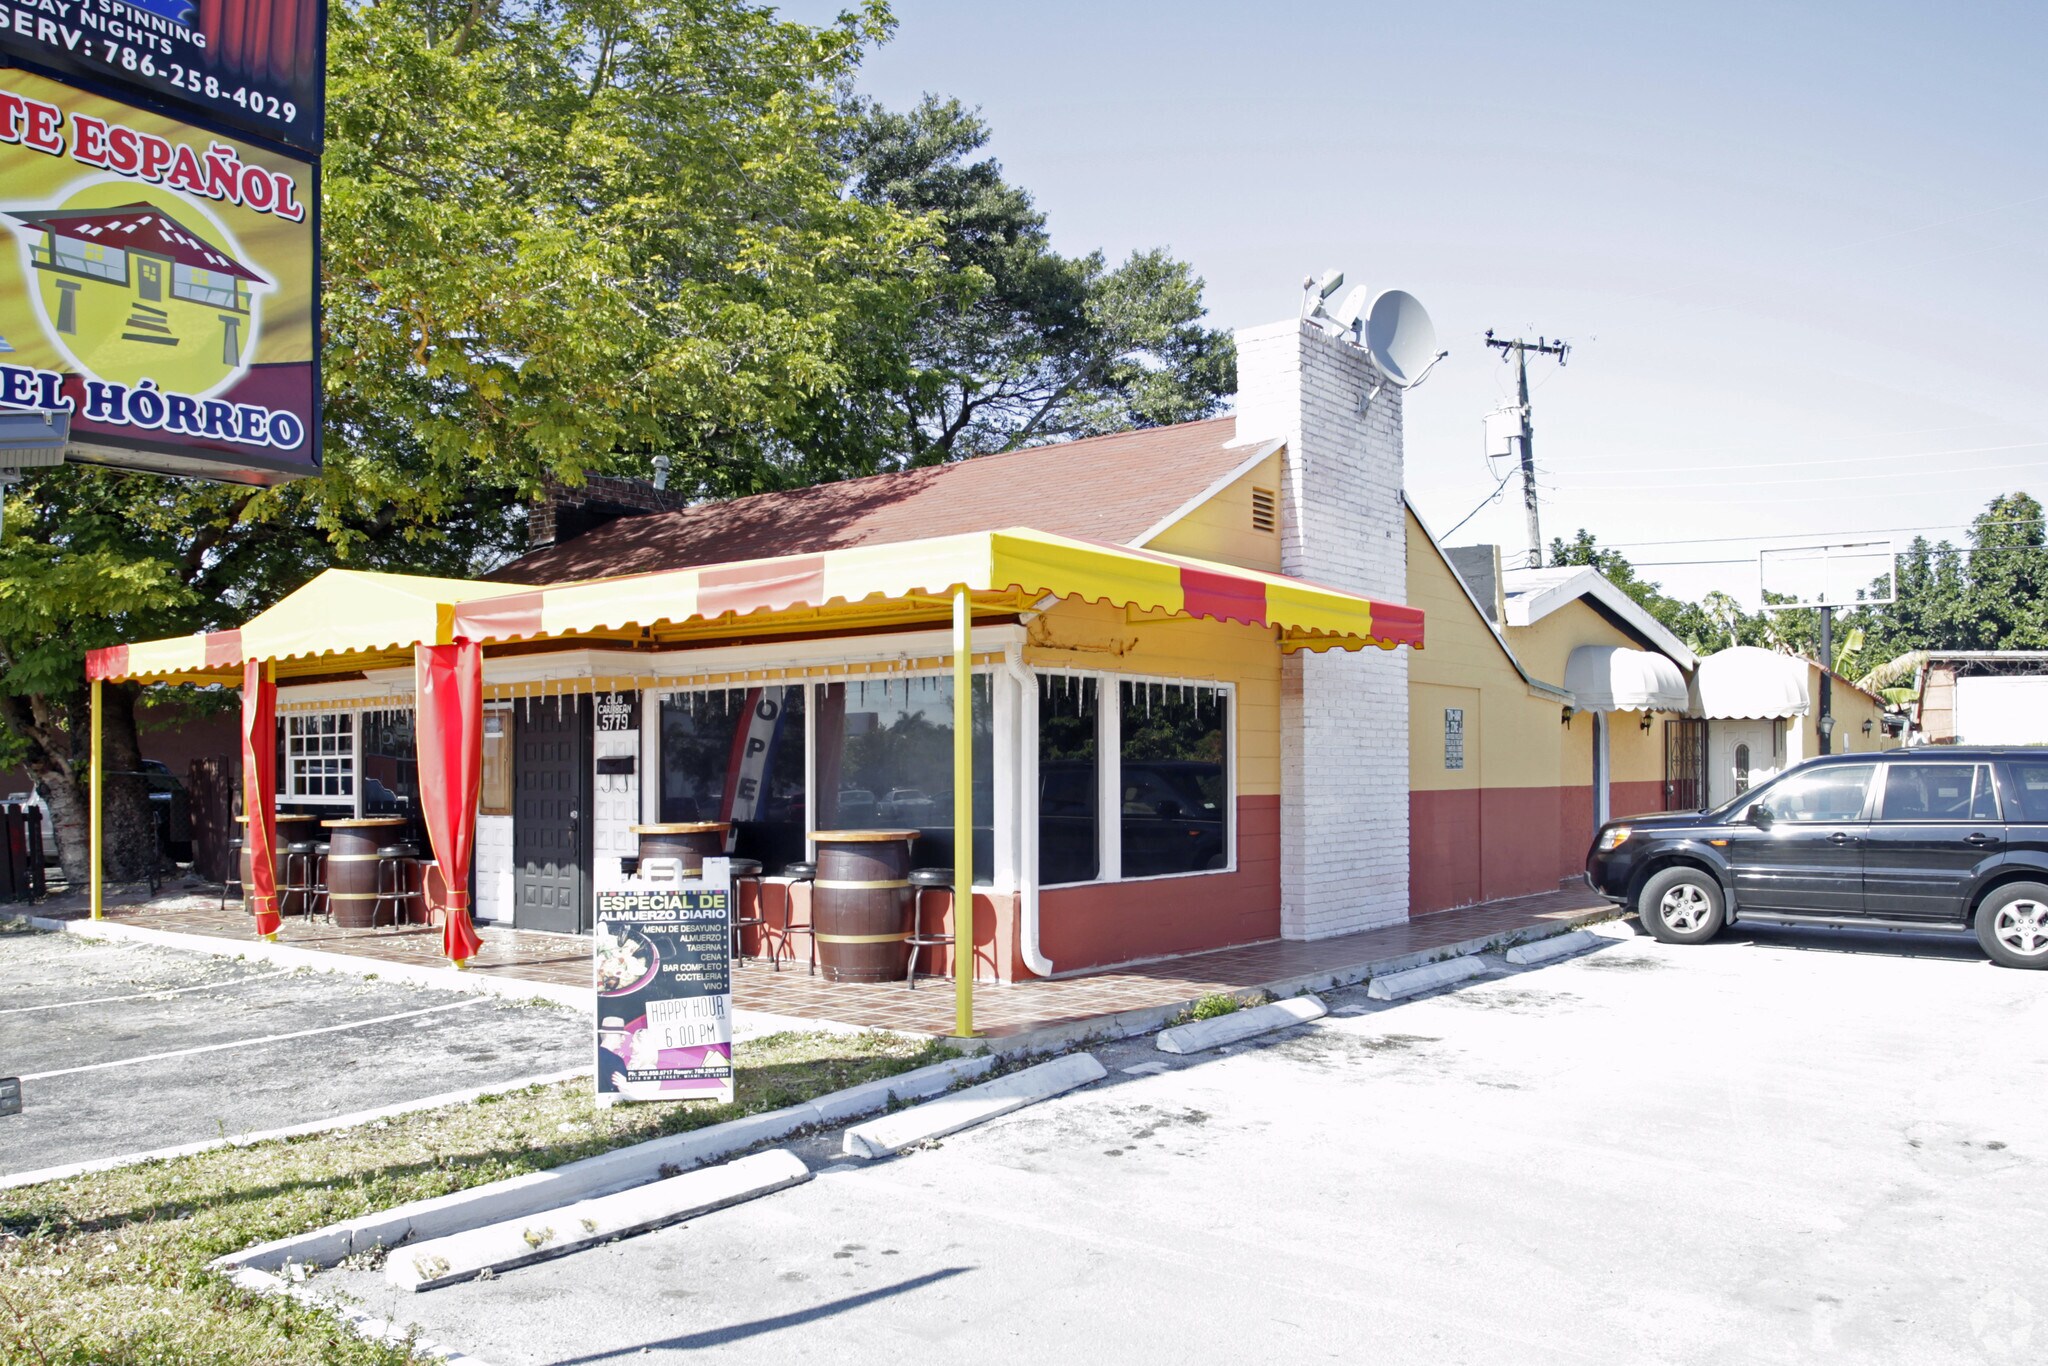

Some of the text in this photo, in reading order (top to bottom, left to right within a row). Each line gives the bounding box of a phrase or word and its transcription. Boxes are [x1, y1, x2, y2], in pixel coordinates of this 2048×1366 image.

[80, 9, 173, 55] NIGHTS
[100, 0, 206, 48] SPINNING
[103, 39, 297, 124] 786-258-4029
[71, 113, 304, 222] ESPAÑOL
[0, 363, 305, 450] EL HÓRREO
[602, 714, 629, 731] 5779
[599, 895, 725, 911] ESPECIAL DE
[599, 909, 726, 921] ALMUERZO DIARIO
[643, 924, 721, 934] MENU DE DESAYUNO
[679, 934, 721, 943] ALMUERZO
[686, 944, 721, 952] TABERNA
[700, 953, 722, 961] CENA
[662, 963, 722, 972] BAR COMPLETO
[675, 973, 722, 981] COCTELERIA
[703, 982, 723, 990] VINO
[651, 996, 724, 1022] HAPPY HOUR
[700, 1022, 715, 1044] PM
